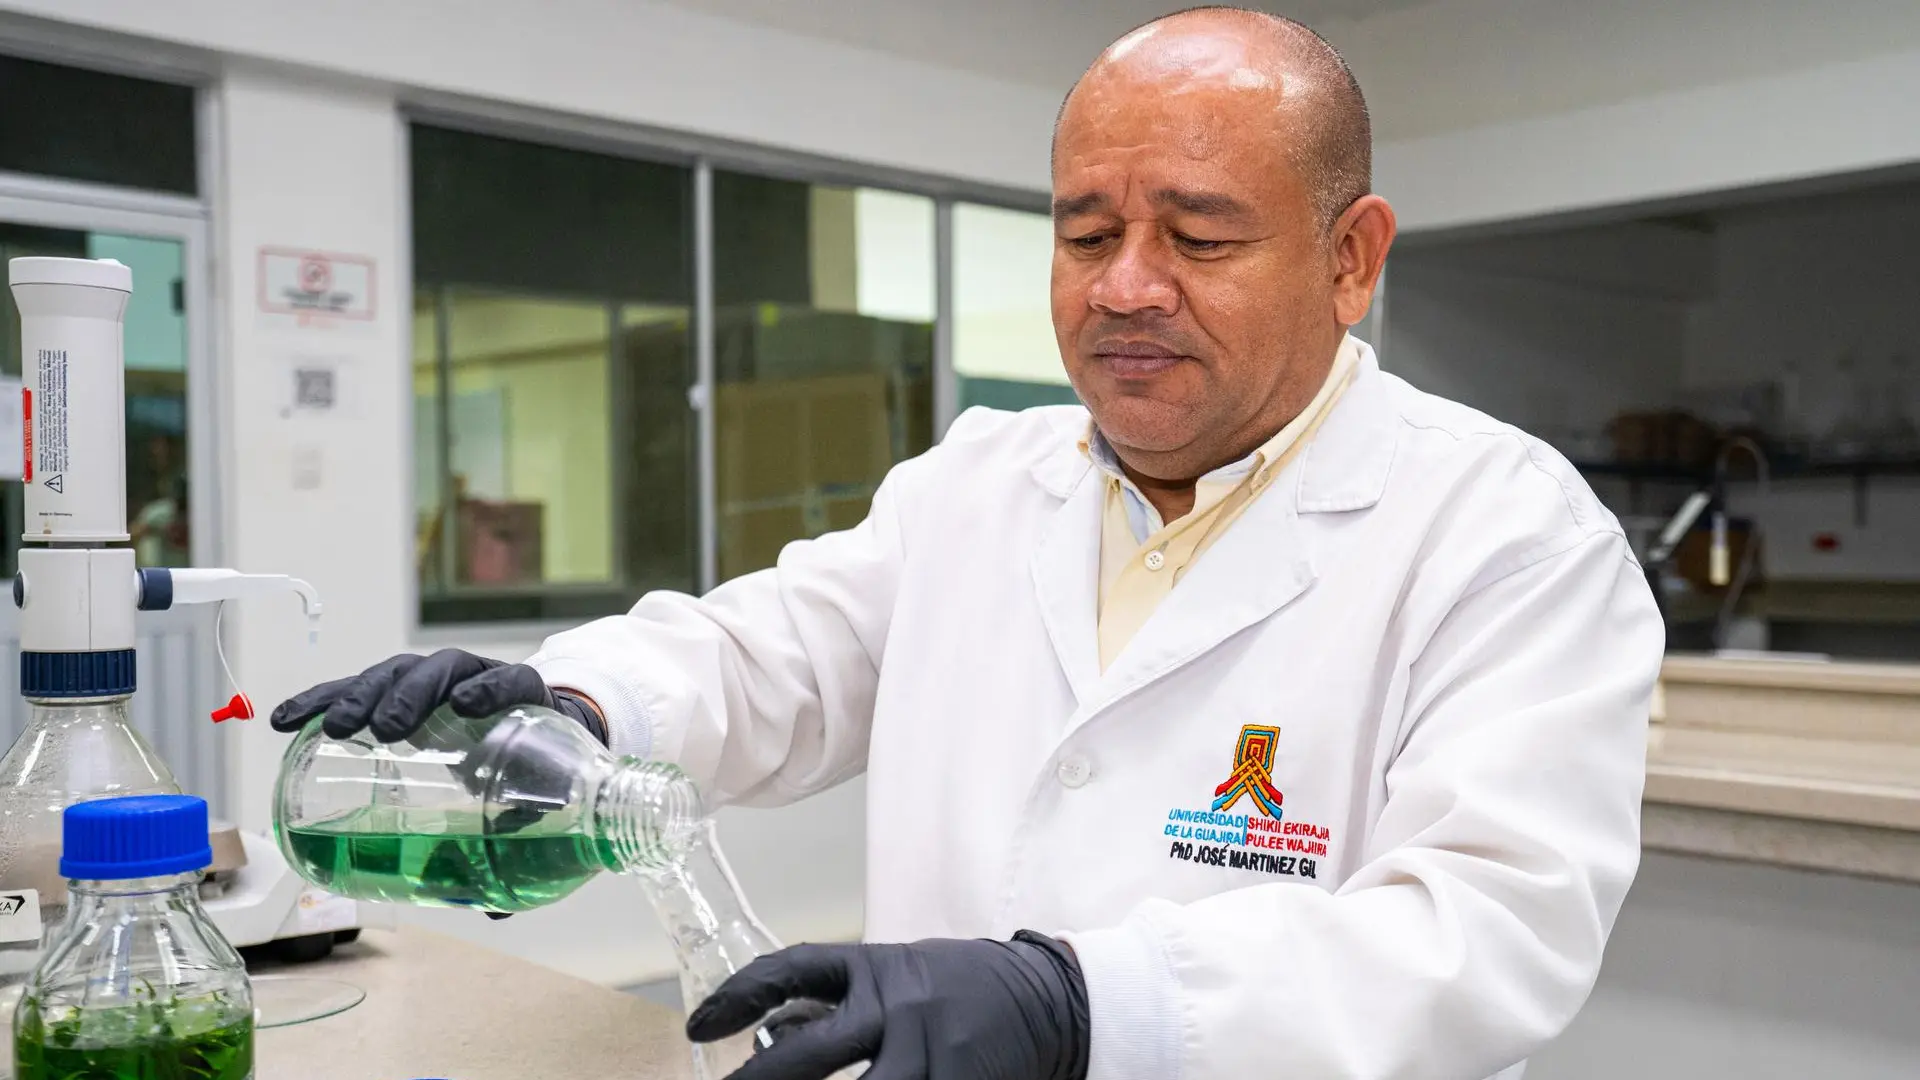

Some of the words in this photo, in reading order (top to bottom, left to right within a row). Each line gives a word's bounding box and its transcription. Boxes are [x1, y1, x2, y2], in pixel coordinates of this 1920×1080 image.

[1168, 808, 1244, 828] UNIVERSIDAD
[1247, 817, 1282, 834] SHIKII
[1164, 824, 1180, 837] DE
[1180, 826, 1193, 839] LA
[1194, 828, 1241, 845] GUAJIRA
[1245, 833, 1284, 850] PULEE
[1169, 841, 1193, 861] PhD
[1193, 843, 1230, 867] JOSÉ
[1229, 850, 1297, 875] MARTINEZ
[1298, 857, 1316, 879] GIL
